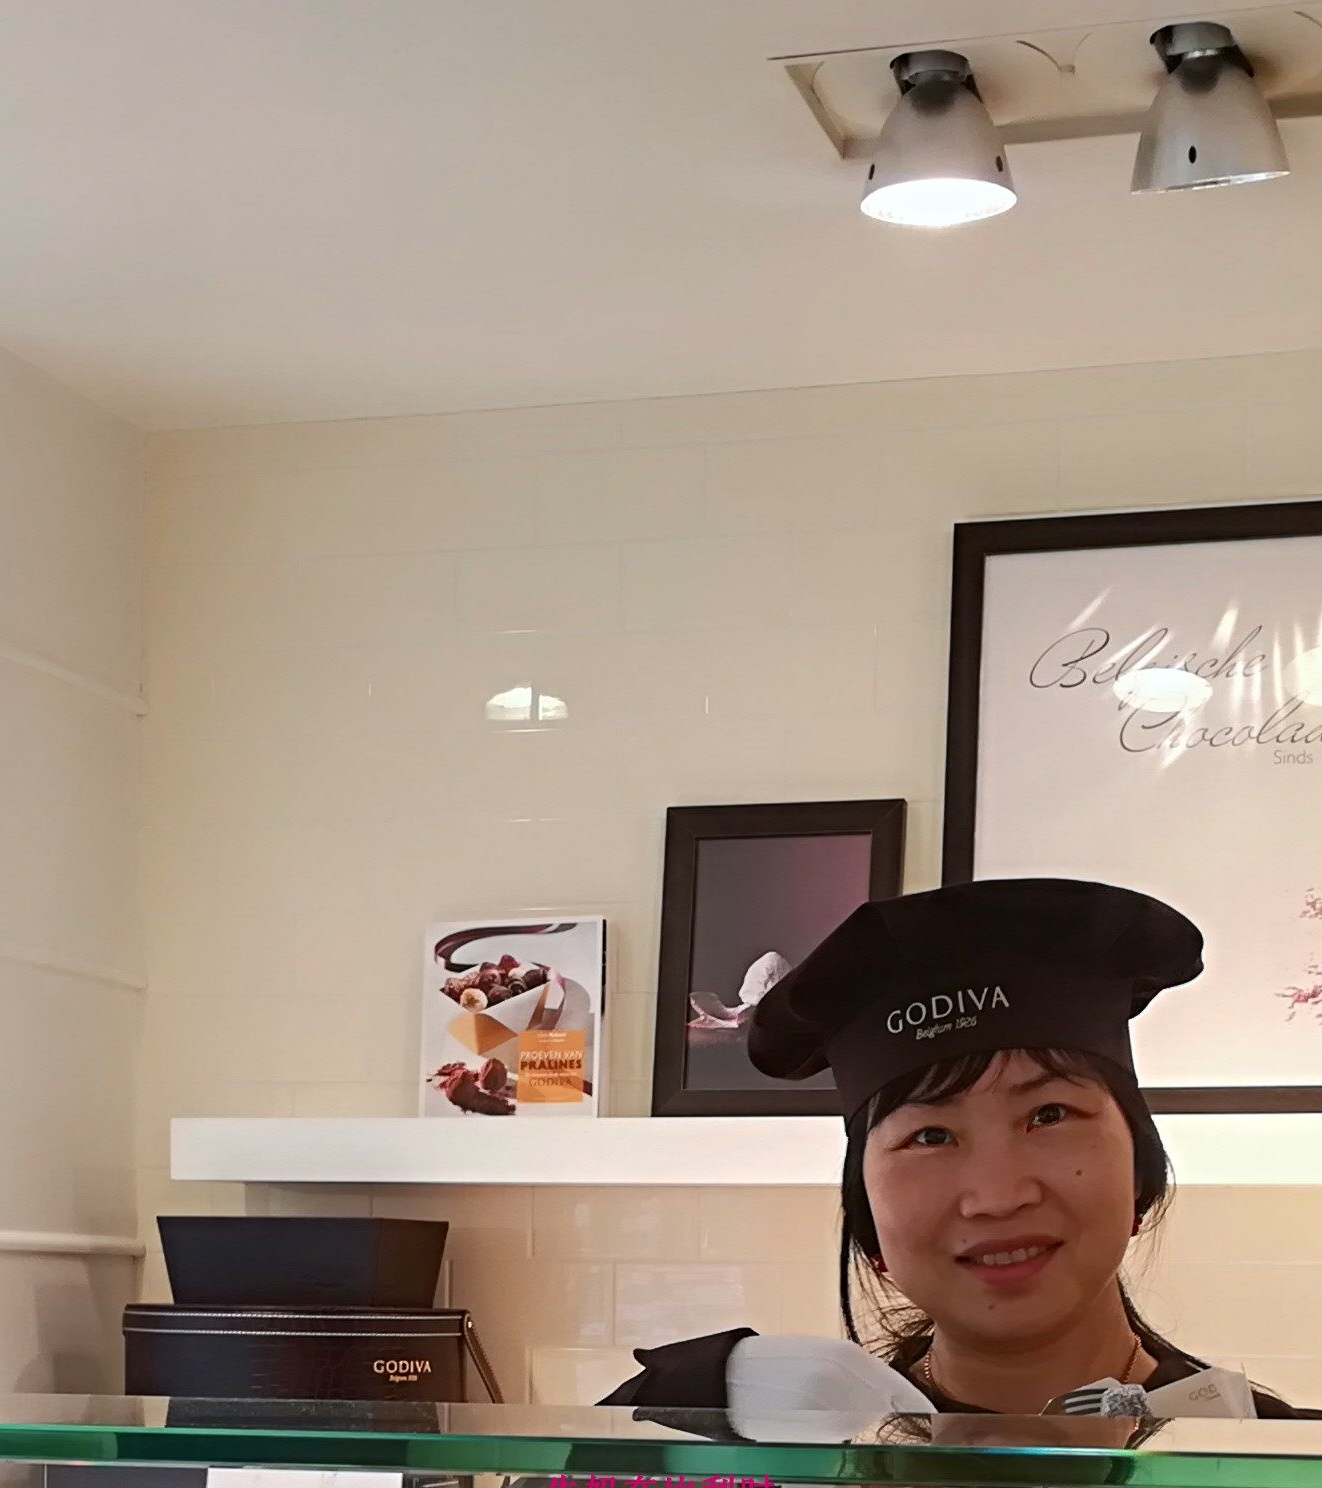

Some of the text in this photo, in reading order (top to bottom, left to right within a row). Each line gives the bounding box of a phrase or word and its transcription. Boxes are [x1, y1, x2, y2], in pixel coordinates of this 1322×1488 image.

[1029, 625, 1269, 700] Belische
[1274, 750, 1313, 765] Sinds
[887, 986, 1010, 1034] GODIVA
[916, 1022, 953, 1040] Belgium
[520, 1060, 582, 1070] PRALINES
[373, 1360, 432, 1374] GODIVA
